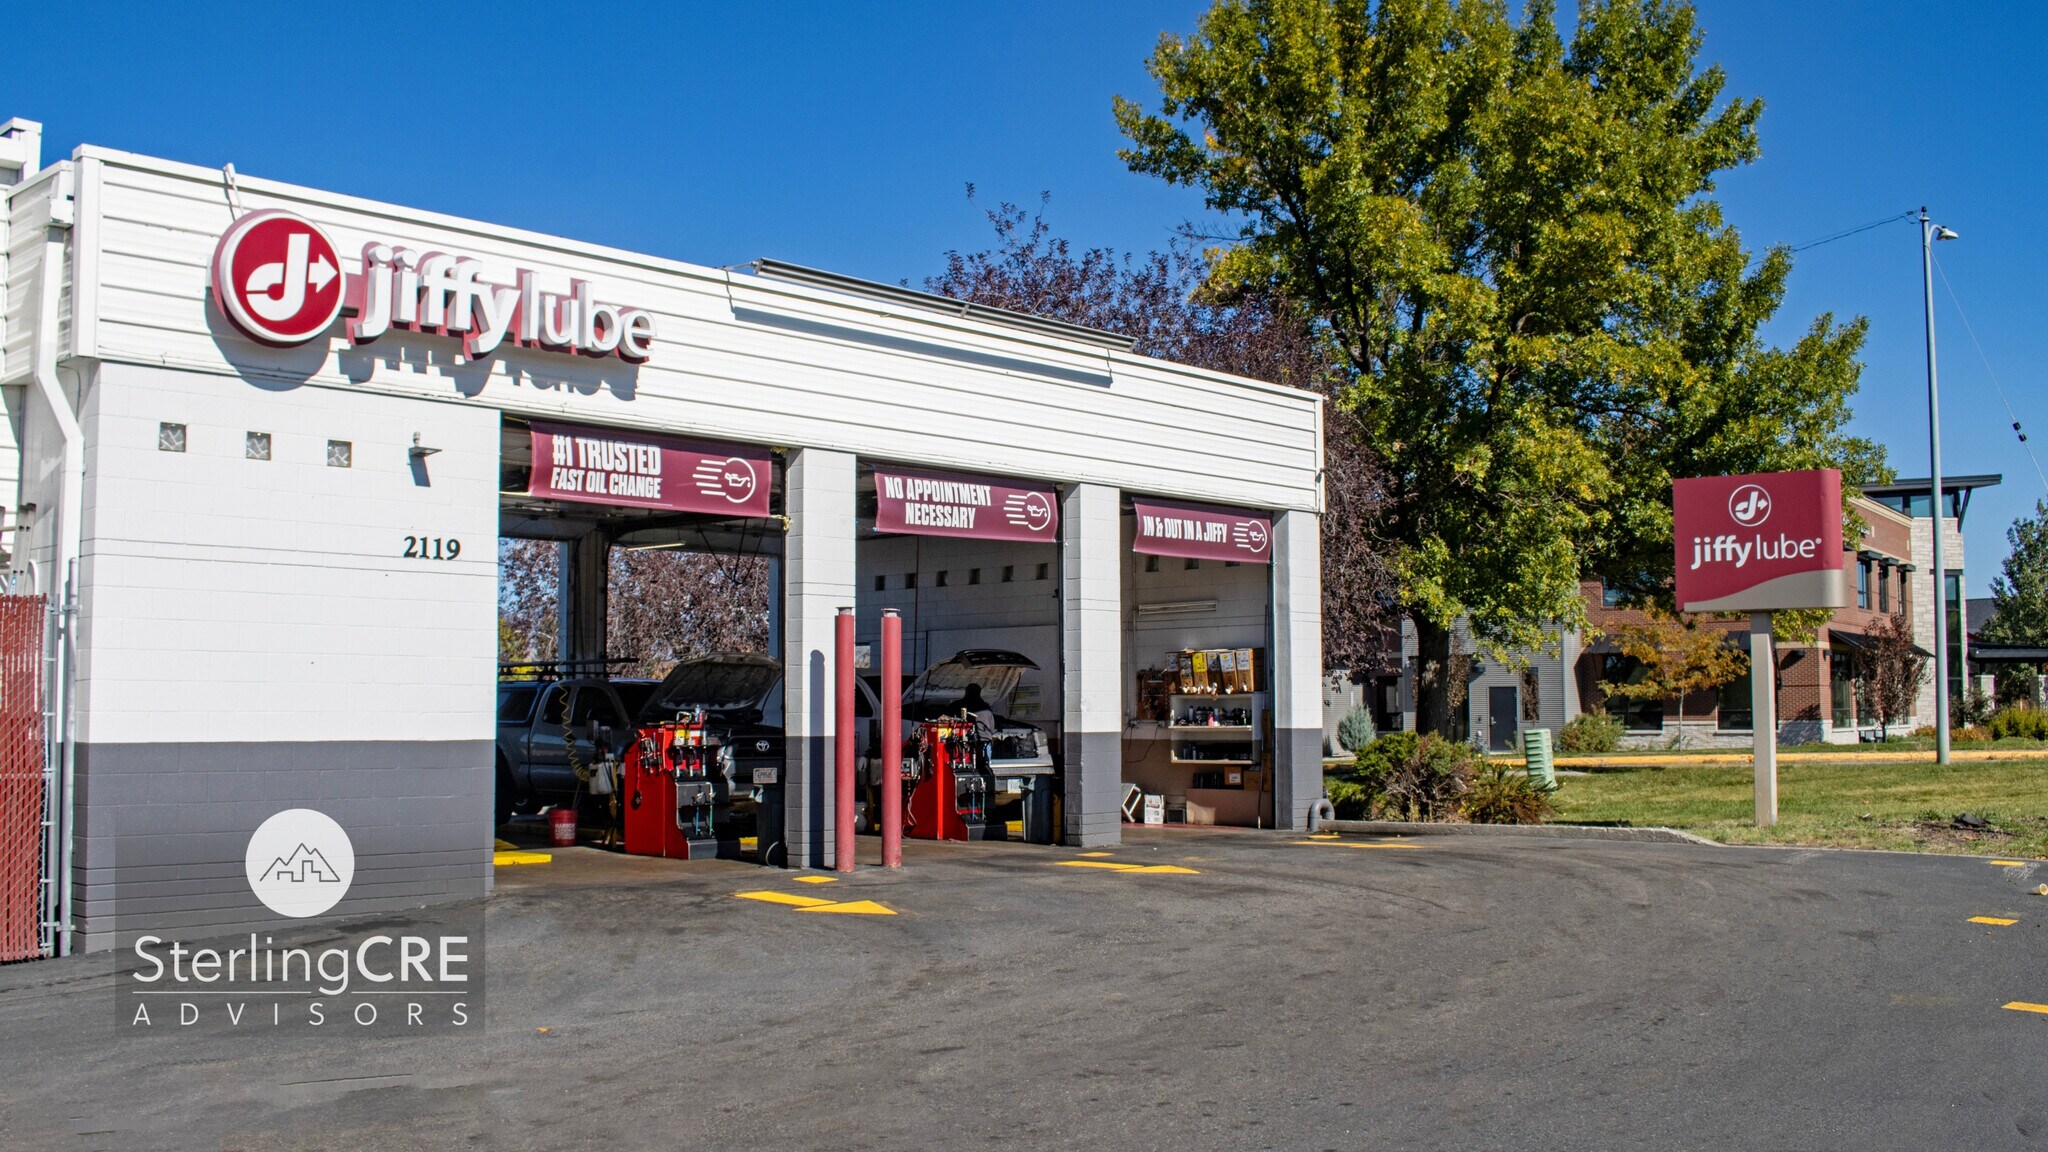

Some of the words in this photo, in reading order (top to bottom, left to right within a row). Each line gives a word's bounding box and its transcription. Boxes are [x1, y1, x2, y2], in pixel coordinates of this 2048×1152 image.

[354, 244, 521, 354] jiffy
[521, 270, 657, 358] lube
[552, 434, 574, 467] #1
[575, 437, 662, 476] TRUSTED
[550, 467, 585, 492] FAST
[585, 471, 607, 494] OIL
[609, 473, 662, 499] CHANGE
[884, 476, 904, 499] NO
[906, 478, 992, 507] APPOINTMENT
[905, 502, 976, 529] NECESSARY
[1143, 515, 1155, 537] IN
[1155, 517, 1163, 538] &
[1164, 517, 1182, 539] OUT
[1183, 519, 1195, 540] IN
[1195, 521, 1203, 541] A
[1203, 522, 1228, 543] JIFFY
[403, 535, 461, 561] 2119
[1691, 534, 1752, 570] jiffy
